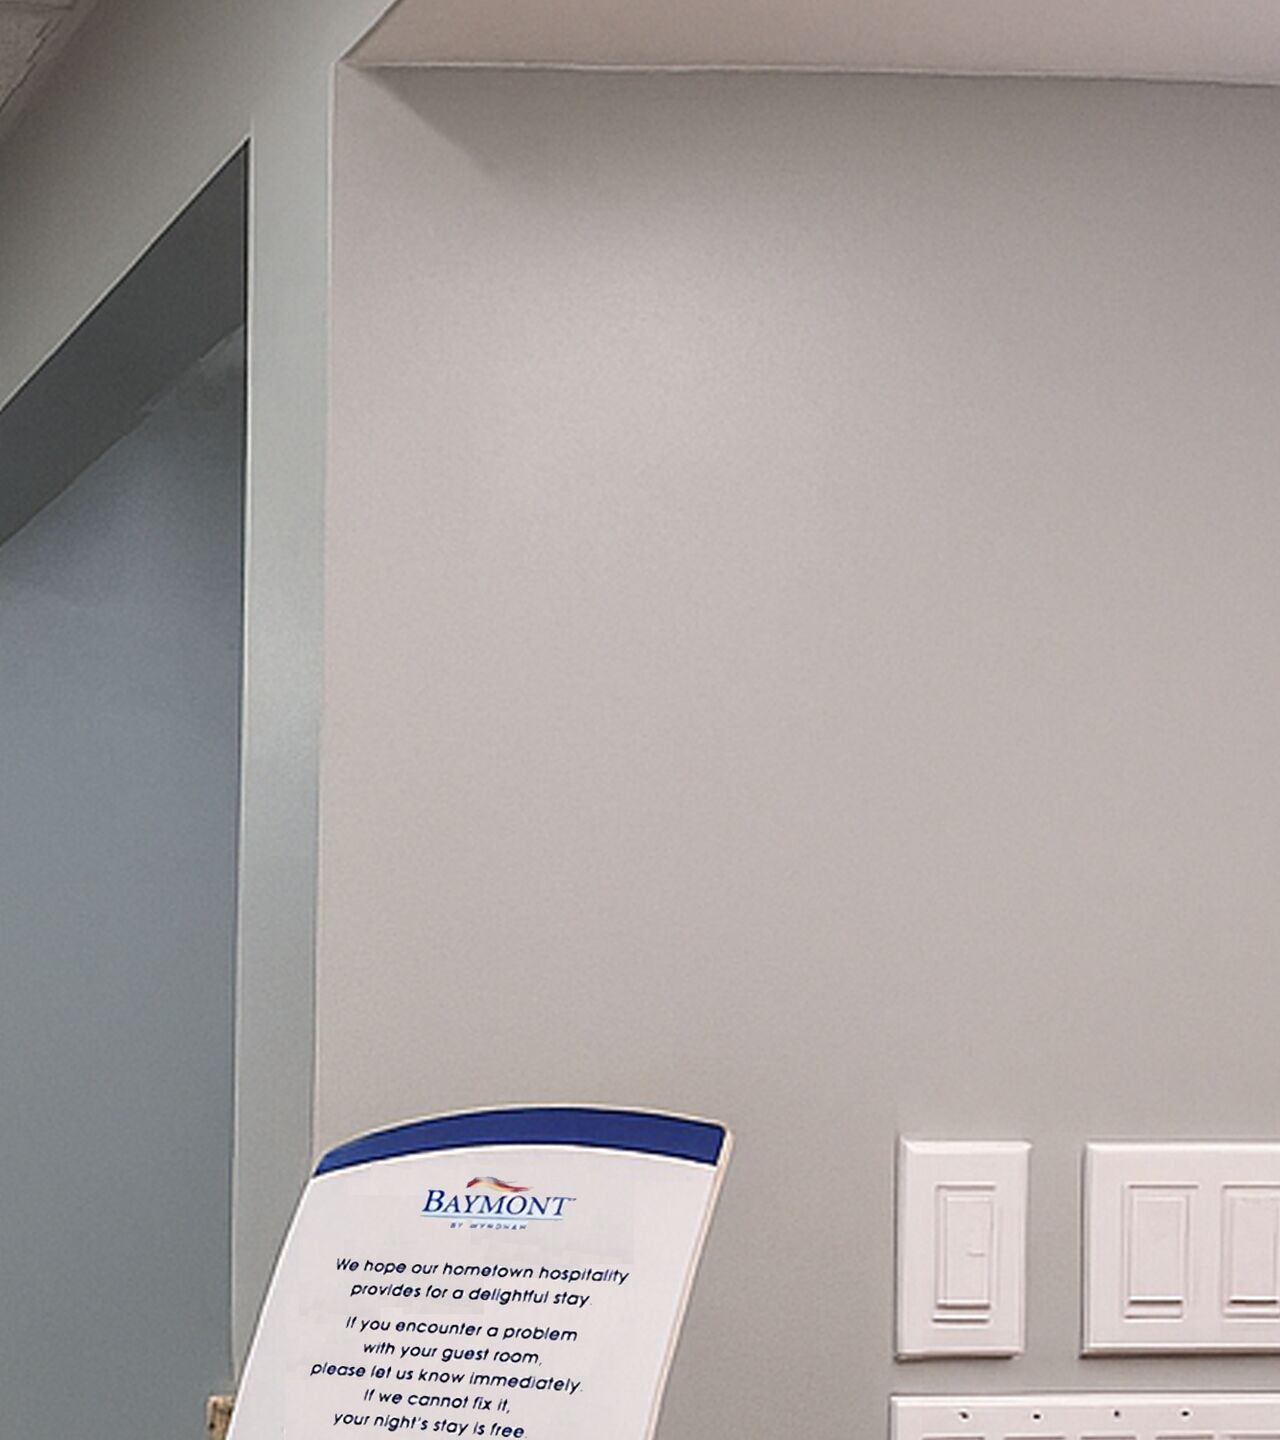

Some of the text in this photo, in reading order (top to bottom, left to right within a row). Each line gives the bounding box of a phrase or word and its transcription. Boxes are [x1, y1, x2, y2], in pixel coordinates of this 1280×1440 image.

[422, 1189, 570, 1216] BAYMONT
[336, 1258, 630, 1285] We hope our hometown hospitality
[350, 1283, 421, 1298] provides
[425, 1284, 448, 1298] for
[452, 1288, 464, 1300] a
[468, 1287, 549, 1306] delightful
[345, 1315, 578, 1342] If you encounter a problem
[363, 1341, 542, 1367] with your guest room,
[310, 1362, 366, 1378] please
[370, 1365, 392, 1379] let
[396, 1368, 414, 1380] us
[418, 1368, 466, 1384] know
[363, 1388, 511, 1414] If we cannot fix it,
[333, 1412, 371, 1426] your
[373, 1414, 429, 1432] night's
[432, 1418, 469, 1437] stay
[472, 1421, 486, 1436] is
